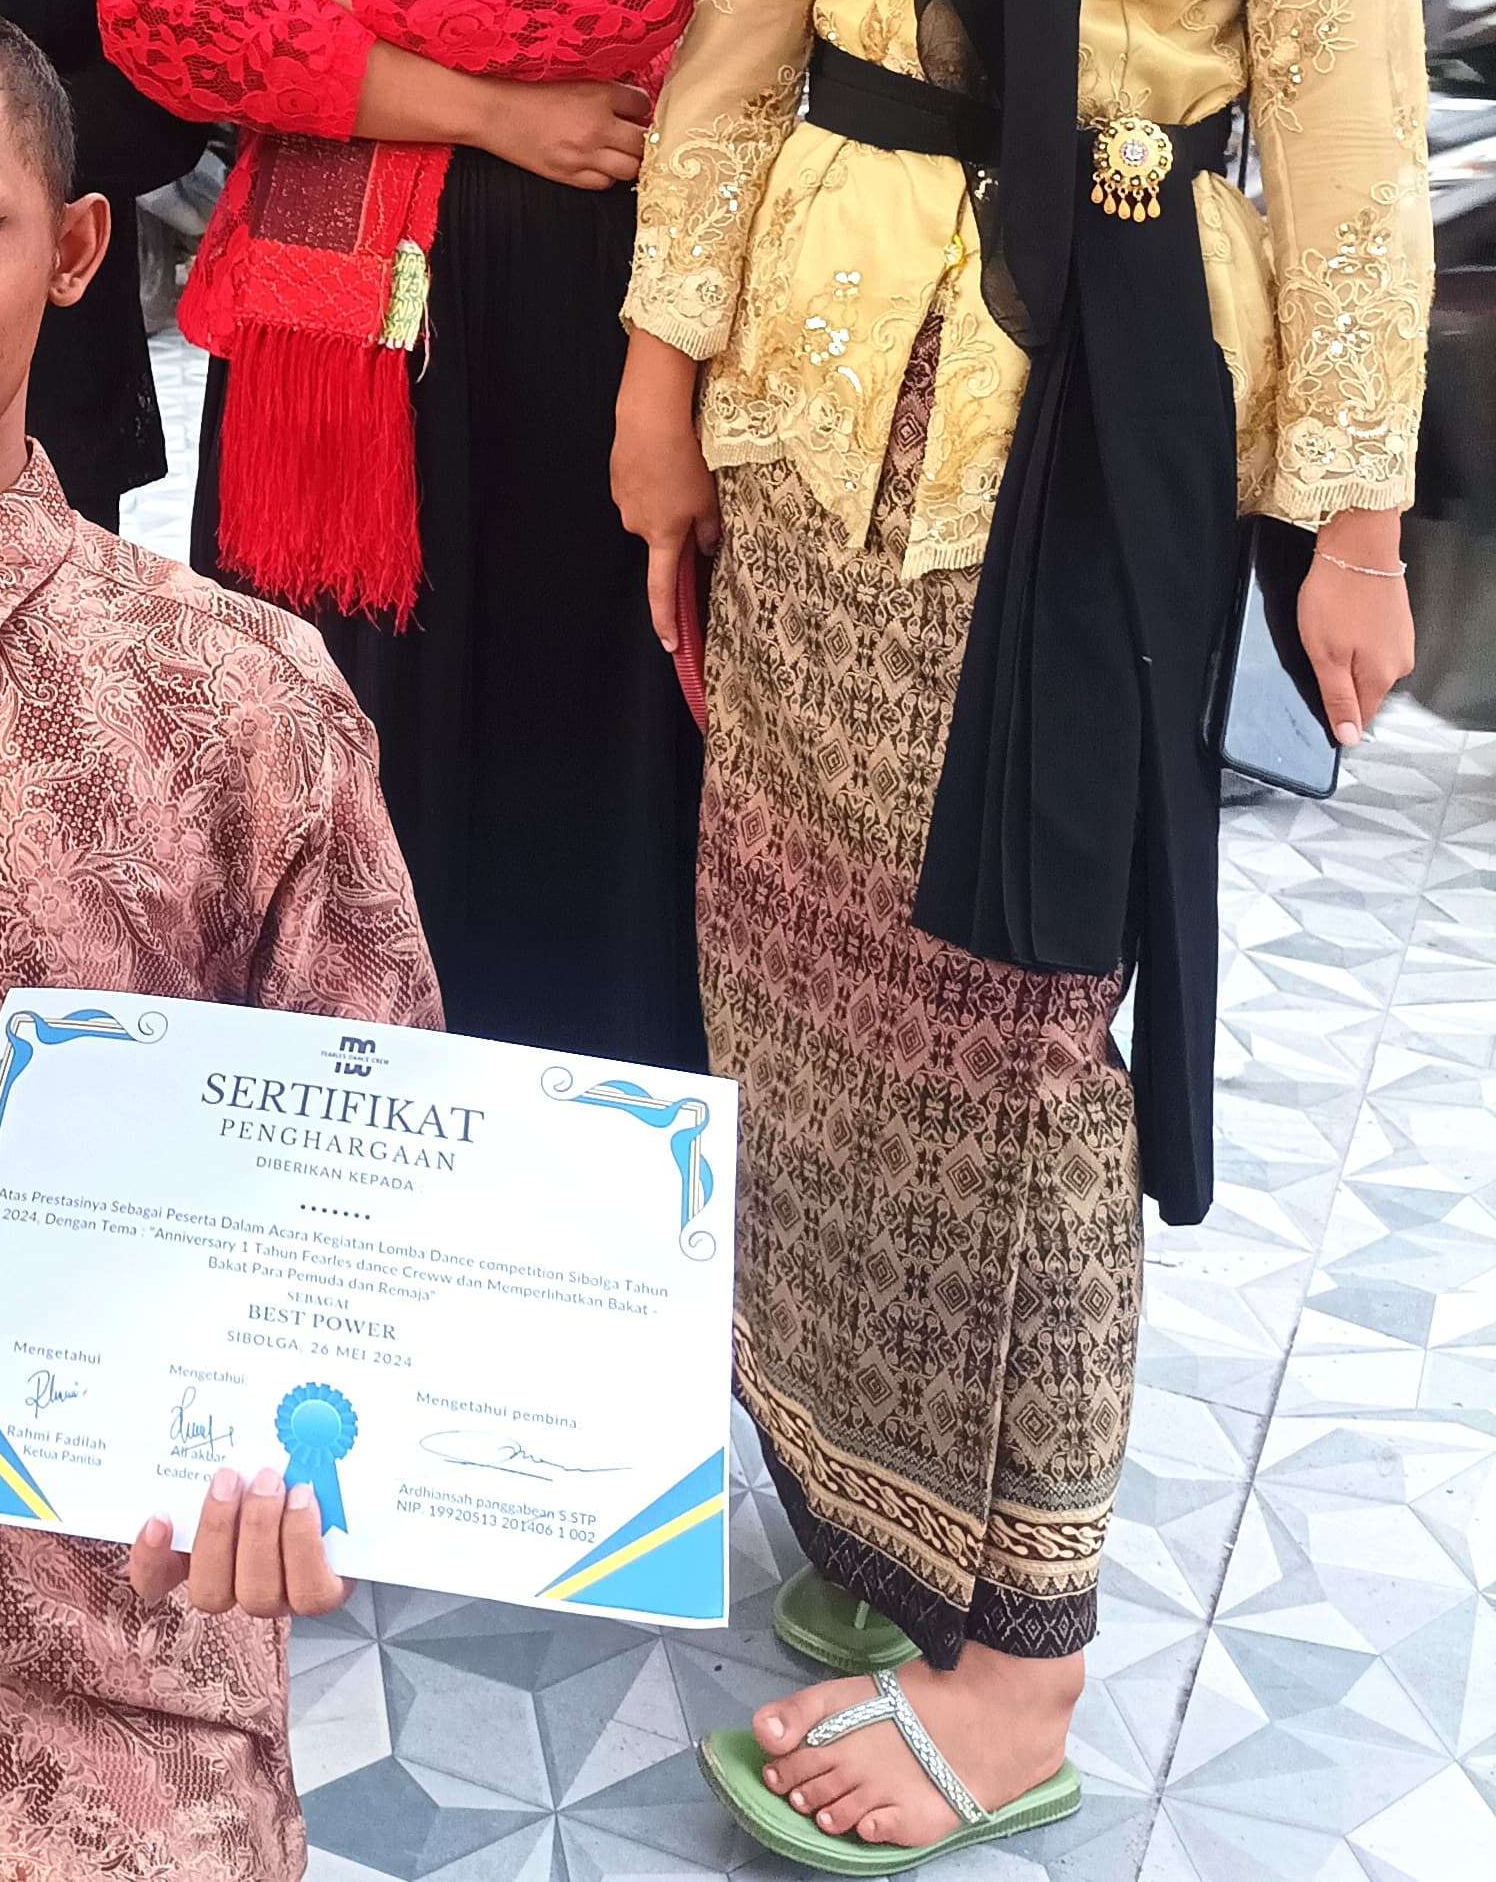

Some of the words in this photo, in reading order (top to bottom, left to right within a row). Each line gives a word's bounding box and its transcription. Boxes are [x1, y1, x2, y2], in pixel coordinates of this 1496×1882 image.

[201, 1073, 484, 1144] SERTIFIKAT
[219, 1118, 455, 1172] PENGHARGAAN
[256, 1156, 342, 1182] DIBERIKAN
[349, 1170, 413, 1192] KEPADA
[32, 1190, 107, 1212] Prestasinya
[110, 1200, 162, 1220] Sebagai
[166, 1208, 216, 1227] Peserta
[221, 1216, 264, 1235] Dalam
[268, 1224, 308, 1241] Acara
[313, 1231, 373, 1252] Kegiatan
[379, 1241, 425, 1260] Lomba
[430, 1248, 474, 1267] Dance
[479, 1260, 563, 1281] competition
[568, 1271, 619, 1291] Sibolga
[625, 1279, 668, 1298] Tahun
[45, 1212, 96, 1230] Dengan
[101, 1219, 137, 1236] Tema
[241, 1241, 248, 1253] 1
[255, 1241, 297, 1260] Tahun
[302, 1250, 351, 1269] Fearles
[356, 1259, 398, 1276] dance
[403, 1266, 453, 1284] Creww
[457, 1275, 482, 1289] dan
[488, 1279, 603, 1308] Memperlihatkan
[610, 1296, 649, 1315] Bakat
[208, 1256, 247, 1274] Bakat
[252, 1262, 282, 1278] Para
[288, 1267, 343, 1287] Pemuda
[348, 1278, 373, 1292] dan
[288, 1291, 349, 1310] SEBAGAI
[248, 1303, 306, 1326] BEST
[313, 1313, 396, 1340] POWER
[13, 1340, 101, 1365] Mengetahui
[310, 1342, 328, 1358] 26
[336, 1345, 366, 1361] MEI
[373, 1351, 411, 1368] 2024
[417, 1390, 507, 1417] Mengetahui
[6, 1424, 50, 1442] Rahmi
[56, 1432, 106, 1451] Fadilah
[23, 1444, 58, 1460] Ketua
[62, 1450, 102, 1467] Panitia
[156, 1463, 200, 1480] Leader
[398, 1483, 472, 1505] Ardhiansah
[476, 1498, 554, 1521] panggabean
[430, 1505, 497, 1526] 19920513
[501, 1516, 553, 1536] 201406
[558, 1526, 565, 1539] 1
[569, 1528, 595, 1544] 002
